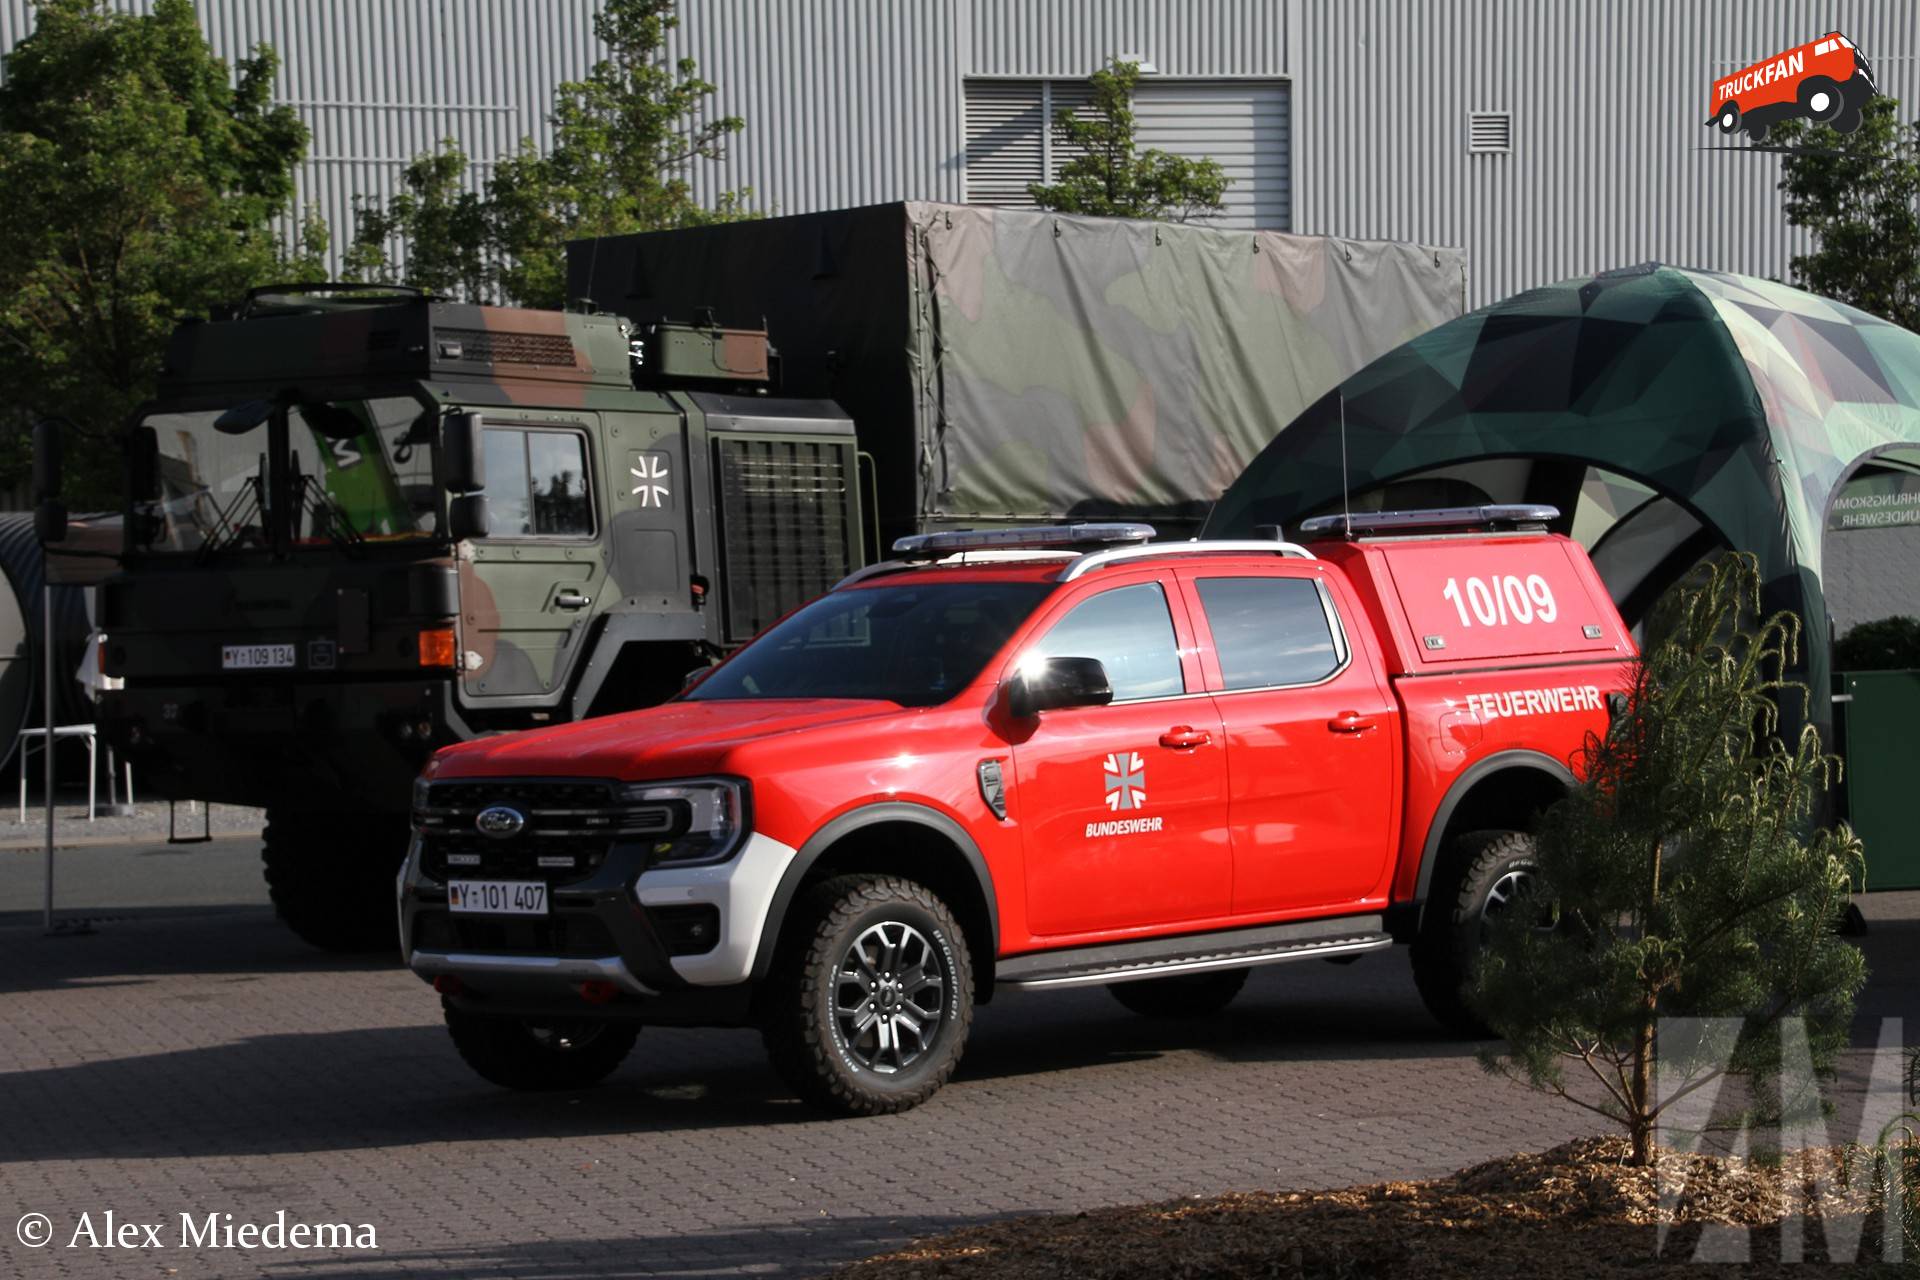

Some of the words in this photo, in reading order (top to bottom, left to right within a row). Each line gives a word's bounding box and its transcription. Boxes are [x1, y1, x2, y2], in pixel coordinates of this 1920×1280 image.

[1443, 574, 1558, 628] 10/09
[271, 647, 293, 665] 134
[1465, 685, 1602, 720] FEUERWEHR
[1085, 817, 1163, 838] BUNDESWEHR
[514, 885, 545, 910] 407
